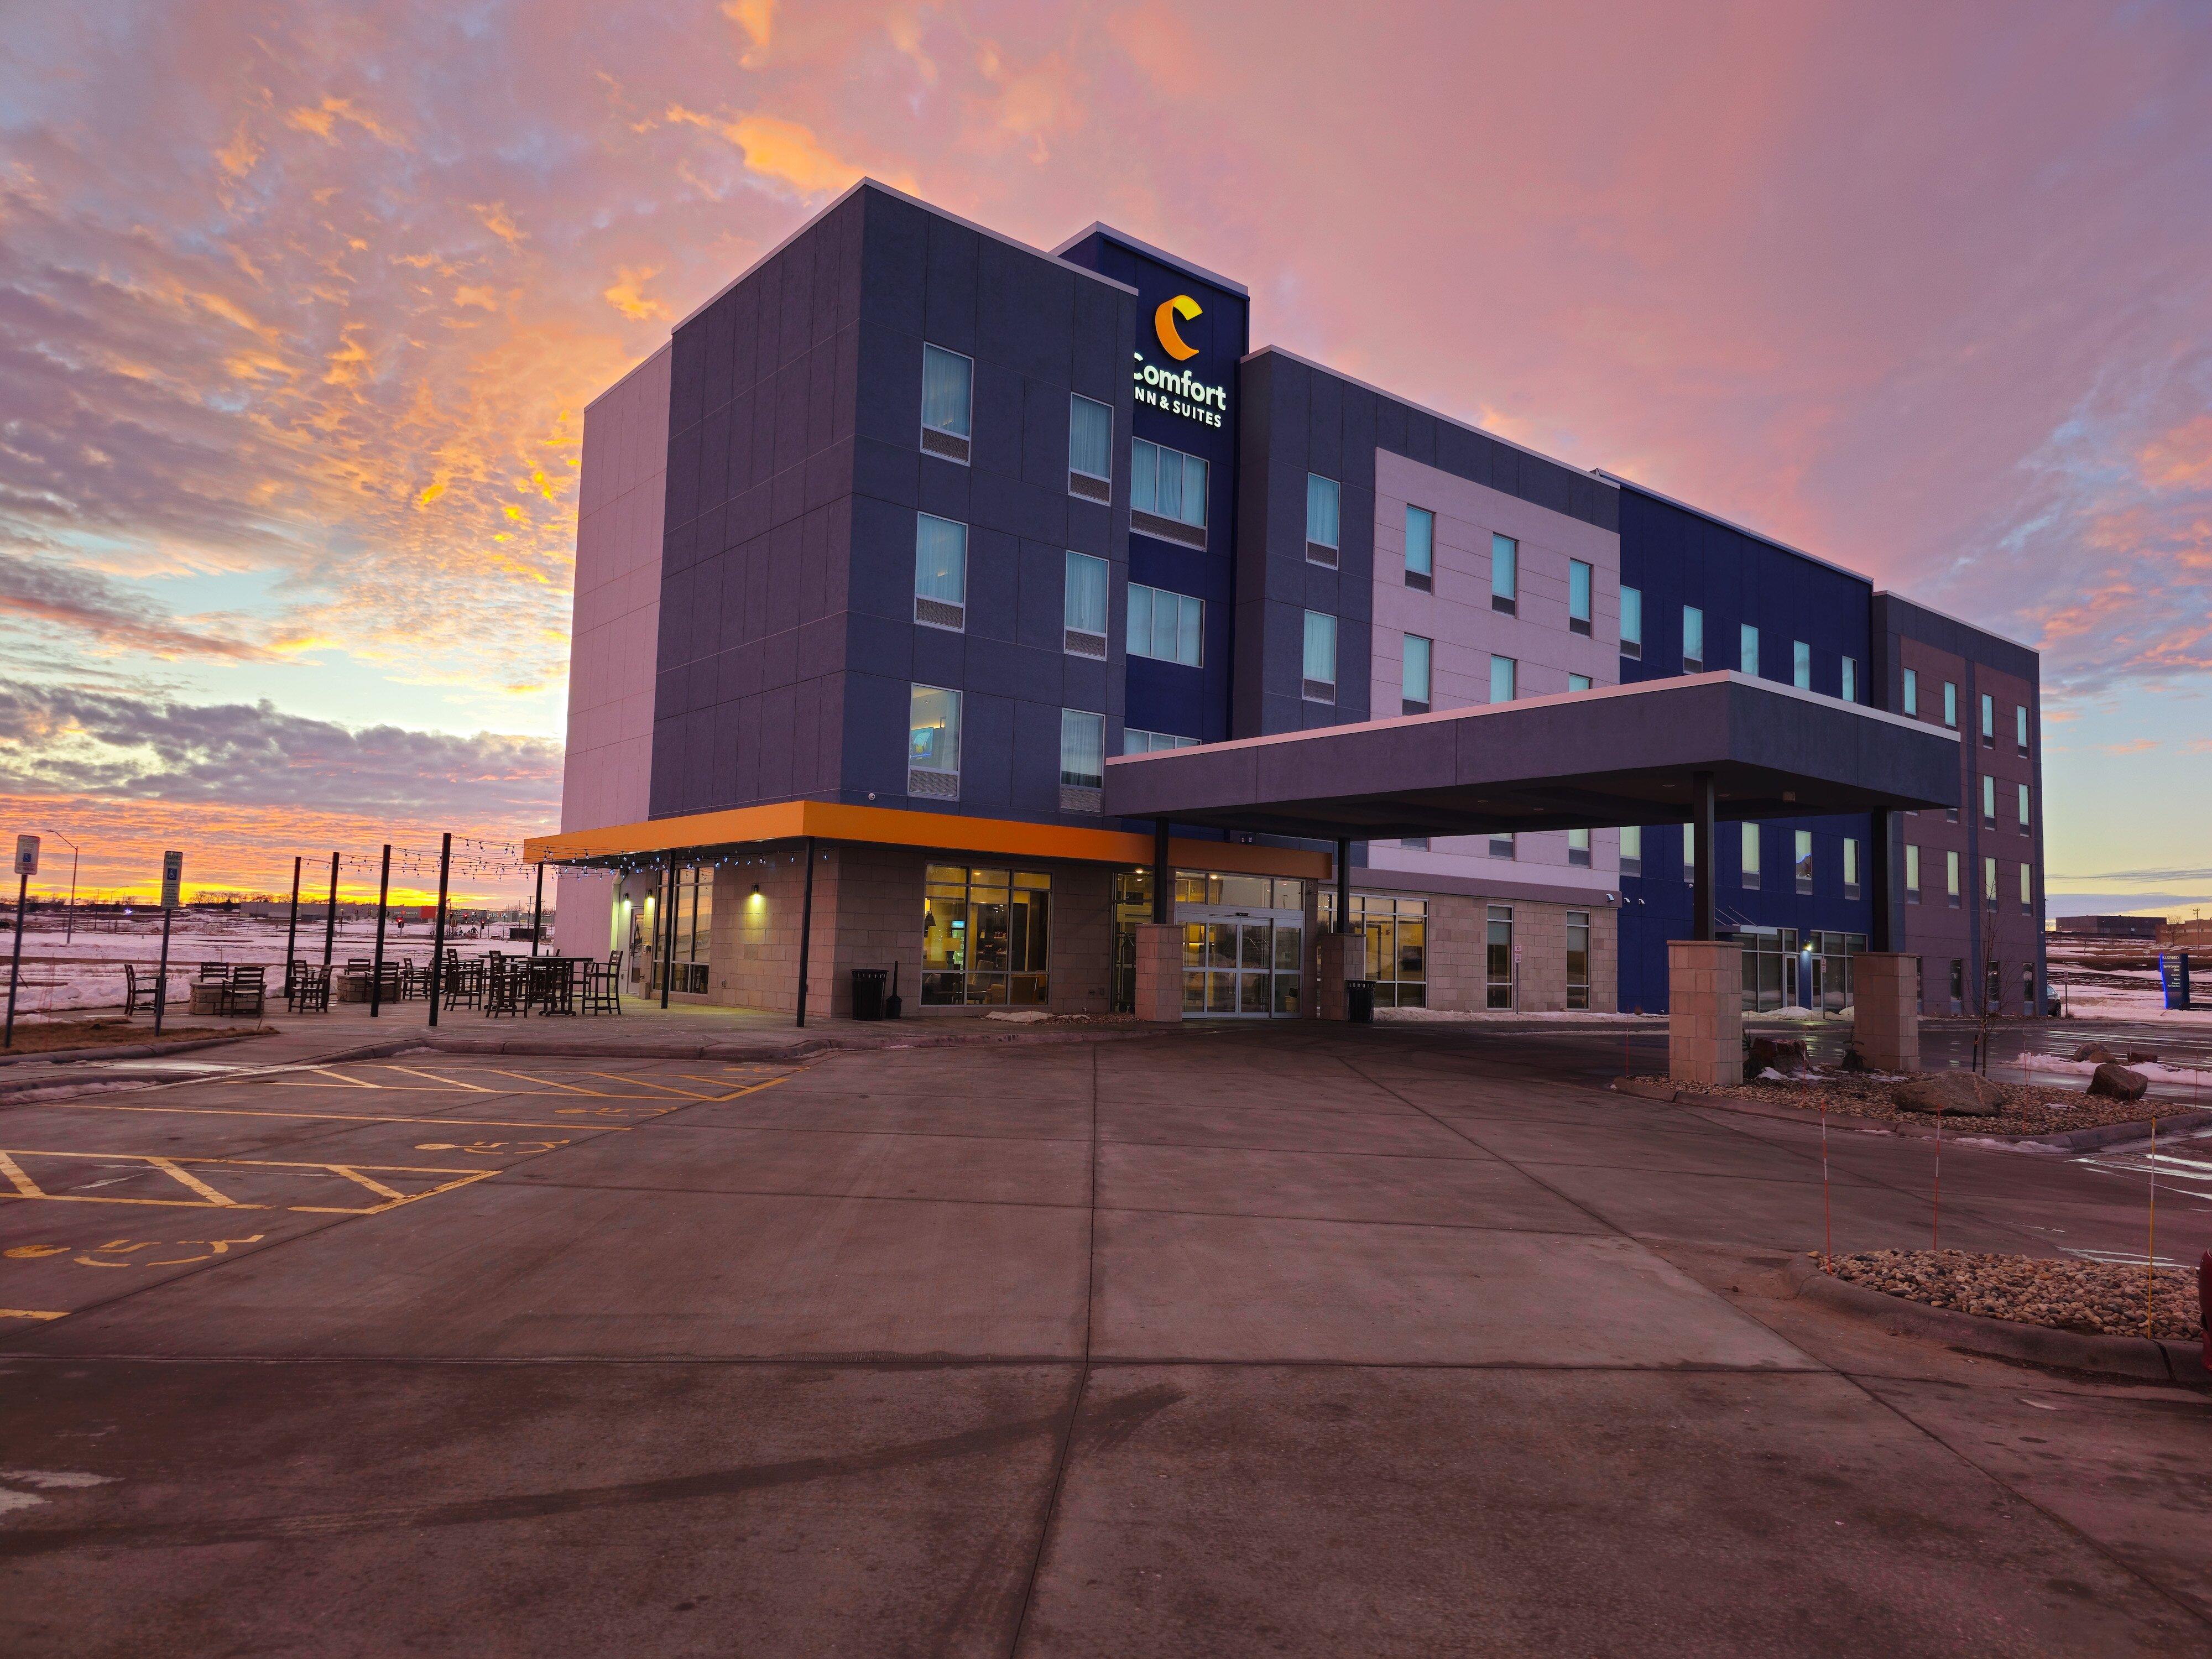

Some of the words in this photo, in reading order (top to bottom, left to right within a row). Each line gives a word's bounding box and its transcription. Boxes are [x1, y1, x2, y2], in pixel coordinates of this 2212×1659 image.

[1134, 352, 1227, 411] Comfort
[1135, 387, 1156, 405] NN
[1160, 395, 1170, 411] &
[1172, 400, 1222, 427] SUITES
